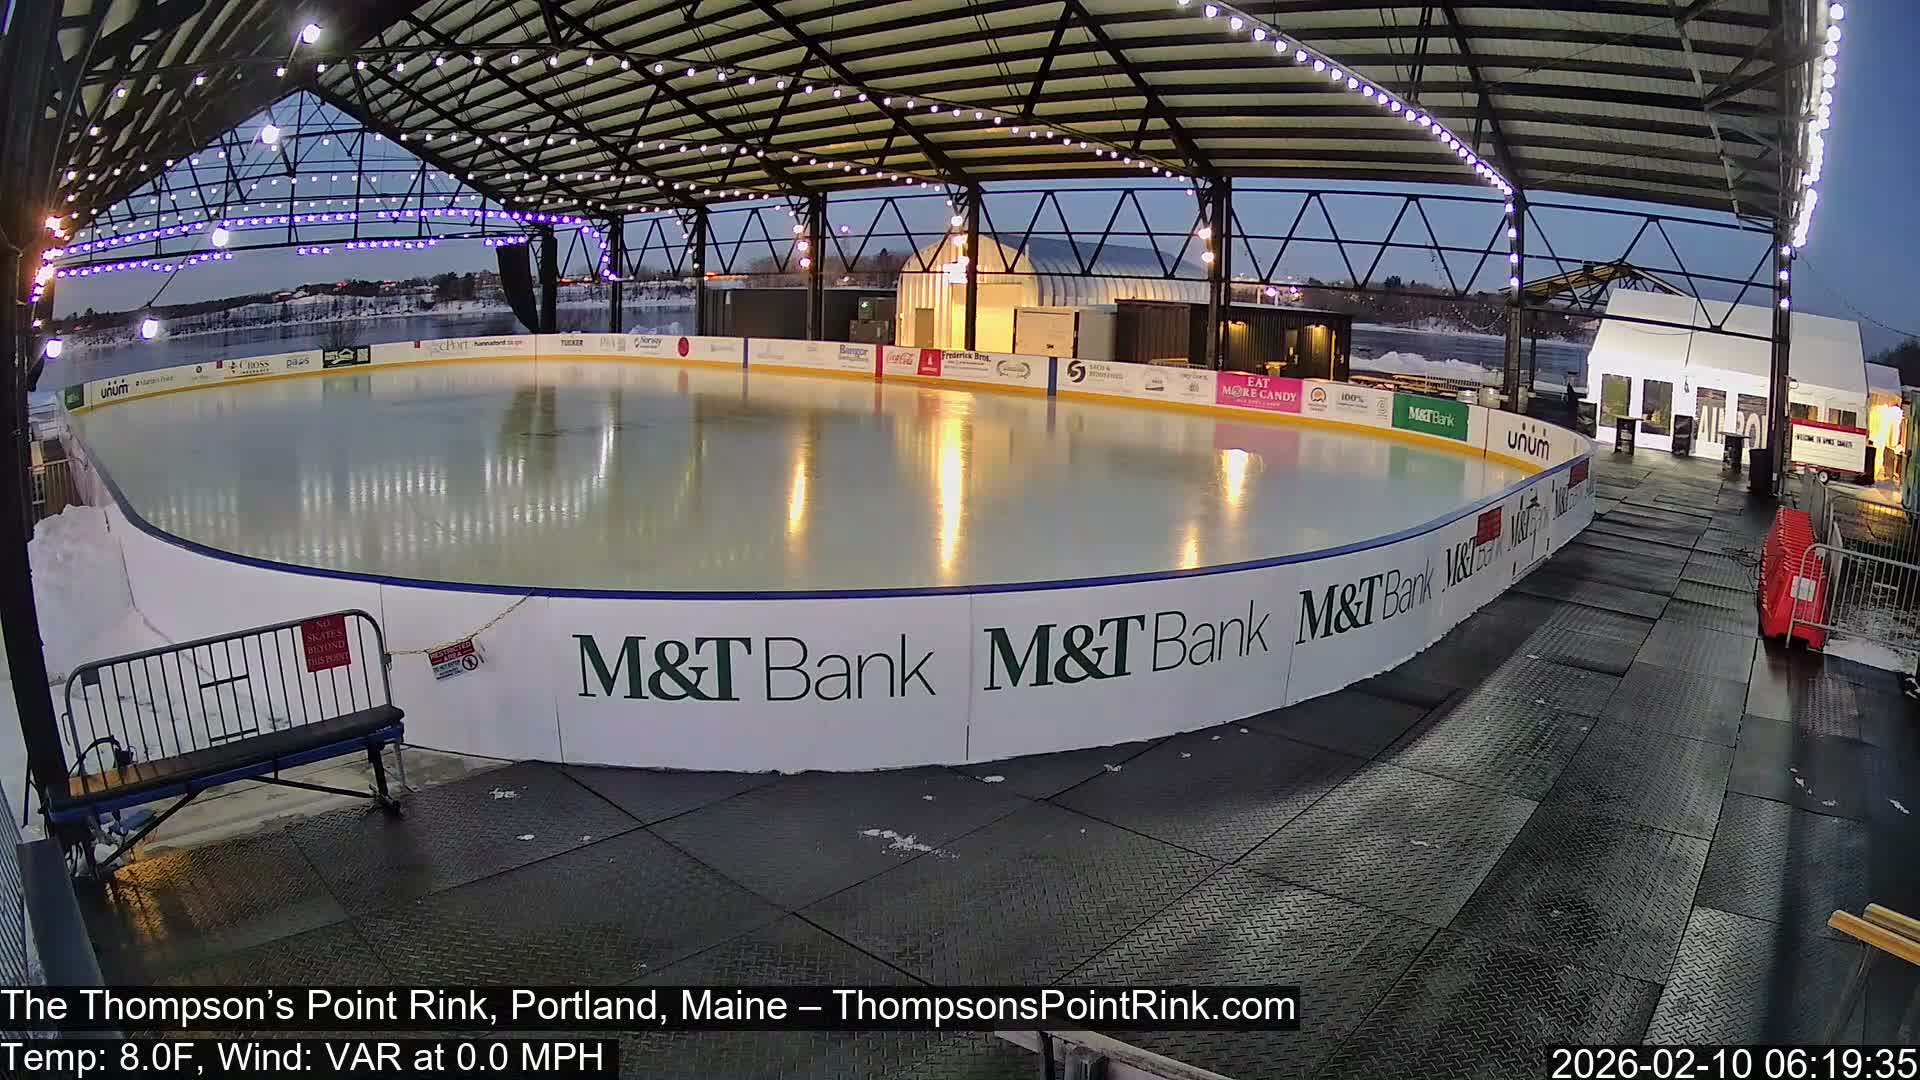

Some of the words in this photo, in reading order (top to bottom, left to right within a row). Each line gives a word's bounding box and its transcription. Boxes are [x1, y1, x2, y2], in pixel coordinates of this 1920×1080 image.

[561, 339, 583, 347] TUCKER
[840, 344, 868, 356] Bangor
[941, 351, 972, 360] Frederick
[974, 352, 992, 362] Bros.
[101, 379, 128, 399] unum
[1247, 376, 1271, 388] EAT
[1221, 386, 1258, 399] MORE
[1258, 389, 1297, 402] CANDY
[1408, 406, 1434, 423] M&T
[1432, 410, 1455, 428] Bank
[1508, 417, 1550, 460] unum
[1442, 536, 1478, 592] M&T
[1295, 574, 1384, 645] M&T
[1382, 557, 1435, 620] Bank
[307, 631, 343, 641] SKATES
[984, 615, 1145, 690] M&T
[1152, 600, 1271, 672] Bank
[308, 641, 345, 655] BEYOND
[572, 634, 752, 701] M&T
[765, 633, 936, 701] Bank
